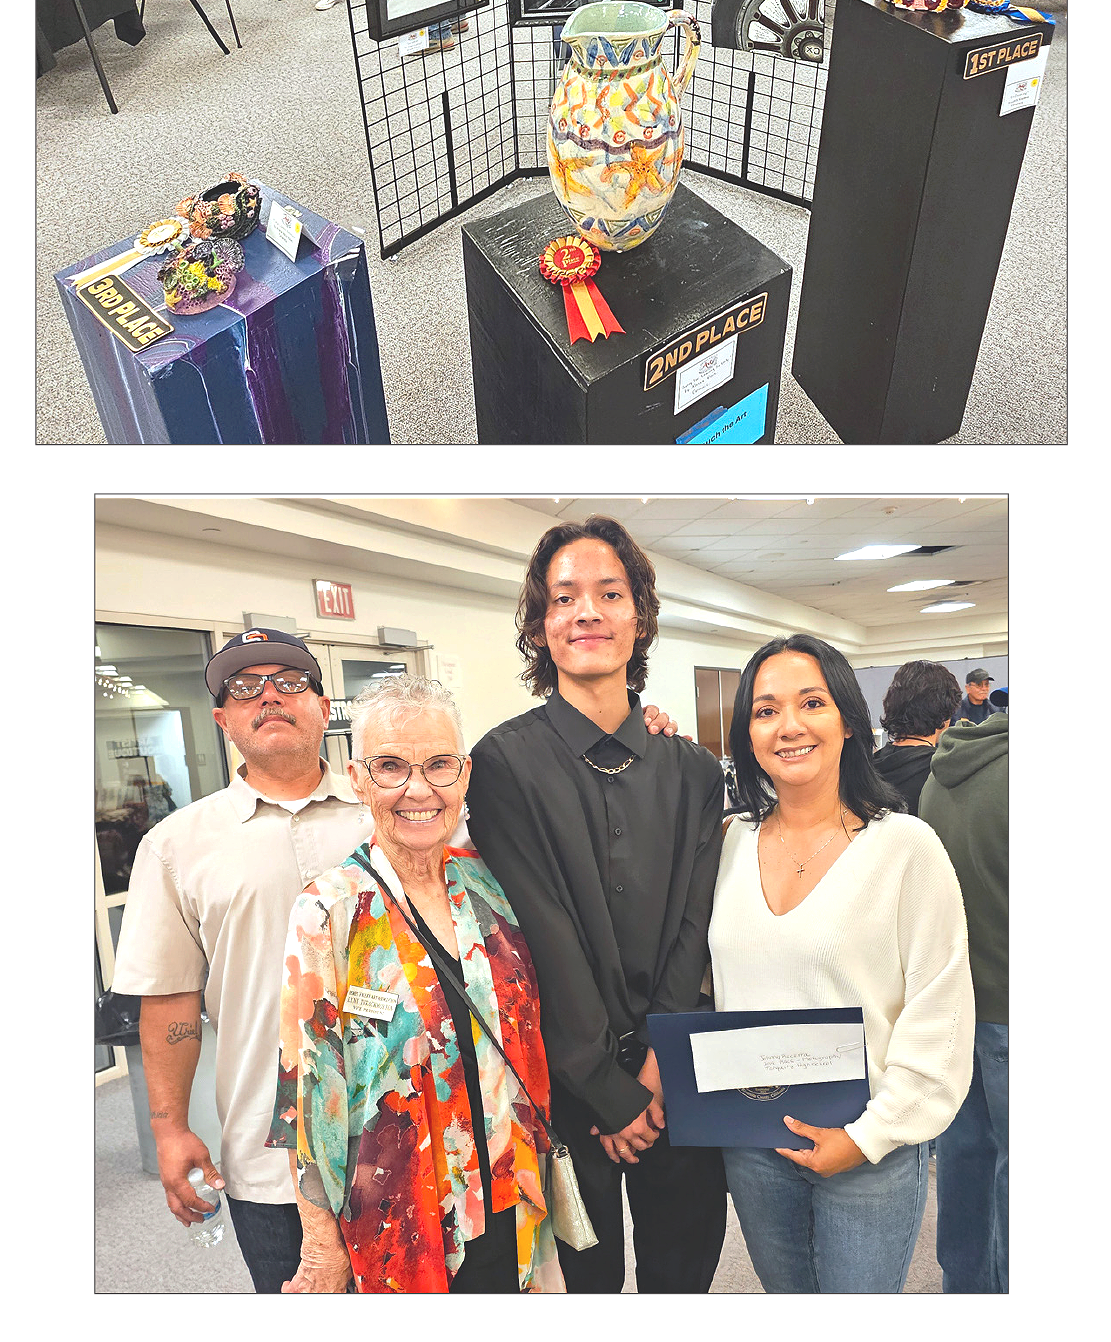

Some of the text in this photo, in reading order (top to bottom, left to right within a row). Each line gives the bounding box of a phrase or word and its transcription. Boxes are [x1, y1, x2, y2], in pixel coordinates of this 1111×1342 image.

[969, 40, 1039, 75] 1ST PLACE
[88, 277, 165, 345] 3RD PLACE
[649, 341, 693, 385] 2ND
[695, 301, 763, 353] PLACE
[721, 420, 734, 434] the
[735, 411, 747, 424] Art
[322, 584, 350, 615] EXIT
